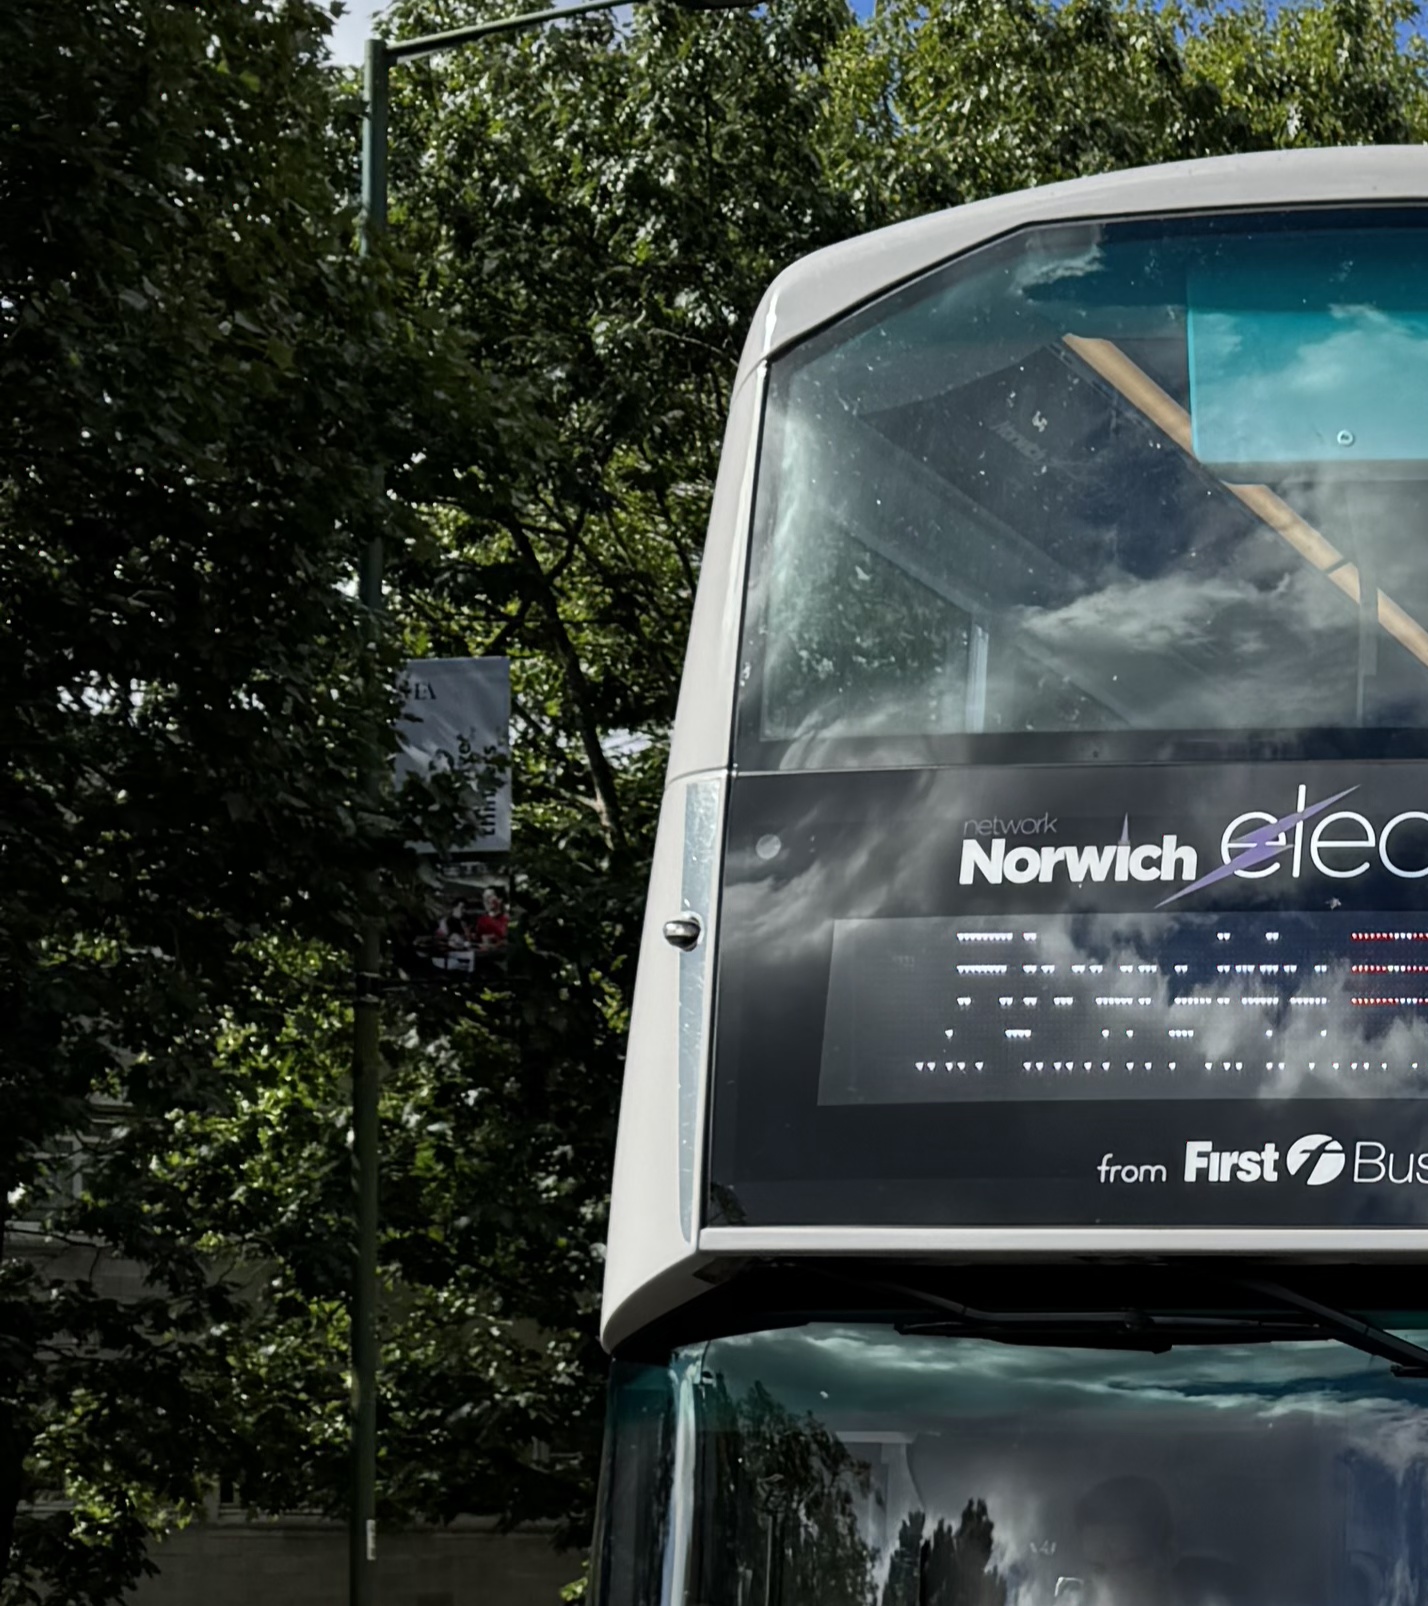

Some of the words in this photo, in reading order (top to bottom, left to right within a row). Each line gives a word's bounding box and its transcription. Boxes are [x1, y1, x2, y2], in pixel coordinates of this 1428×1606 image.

[963, 812, 1058, 836] network
[959, 834, 1198, 885] Norwich
[1097, 1153, 1167, 1183] from
[1184, 1140, 1280, 1183] First
